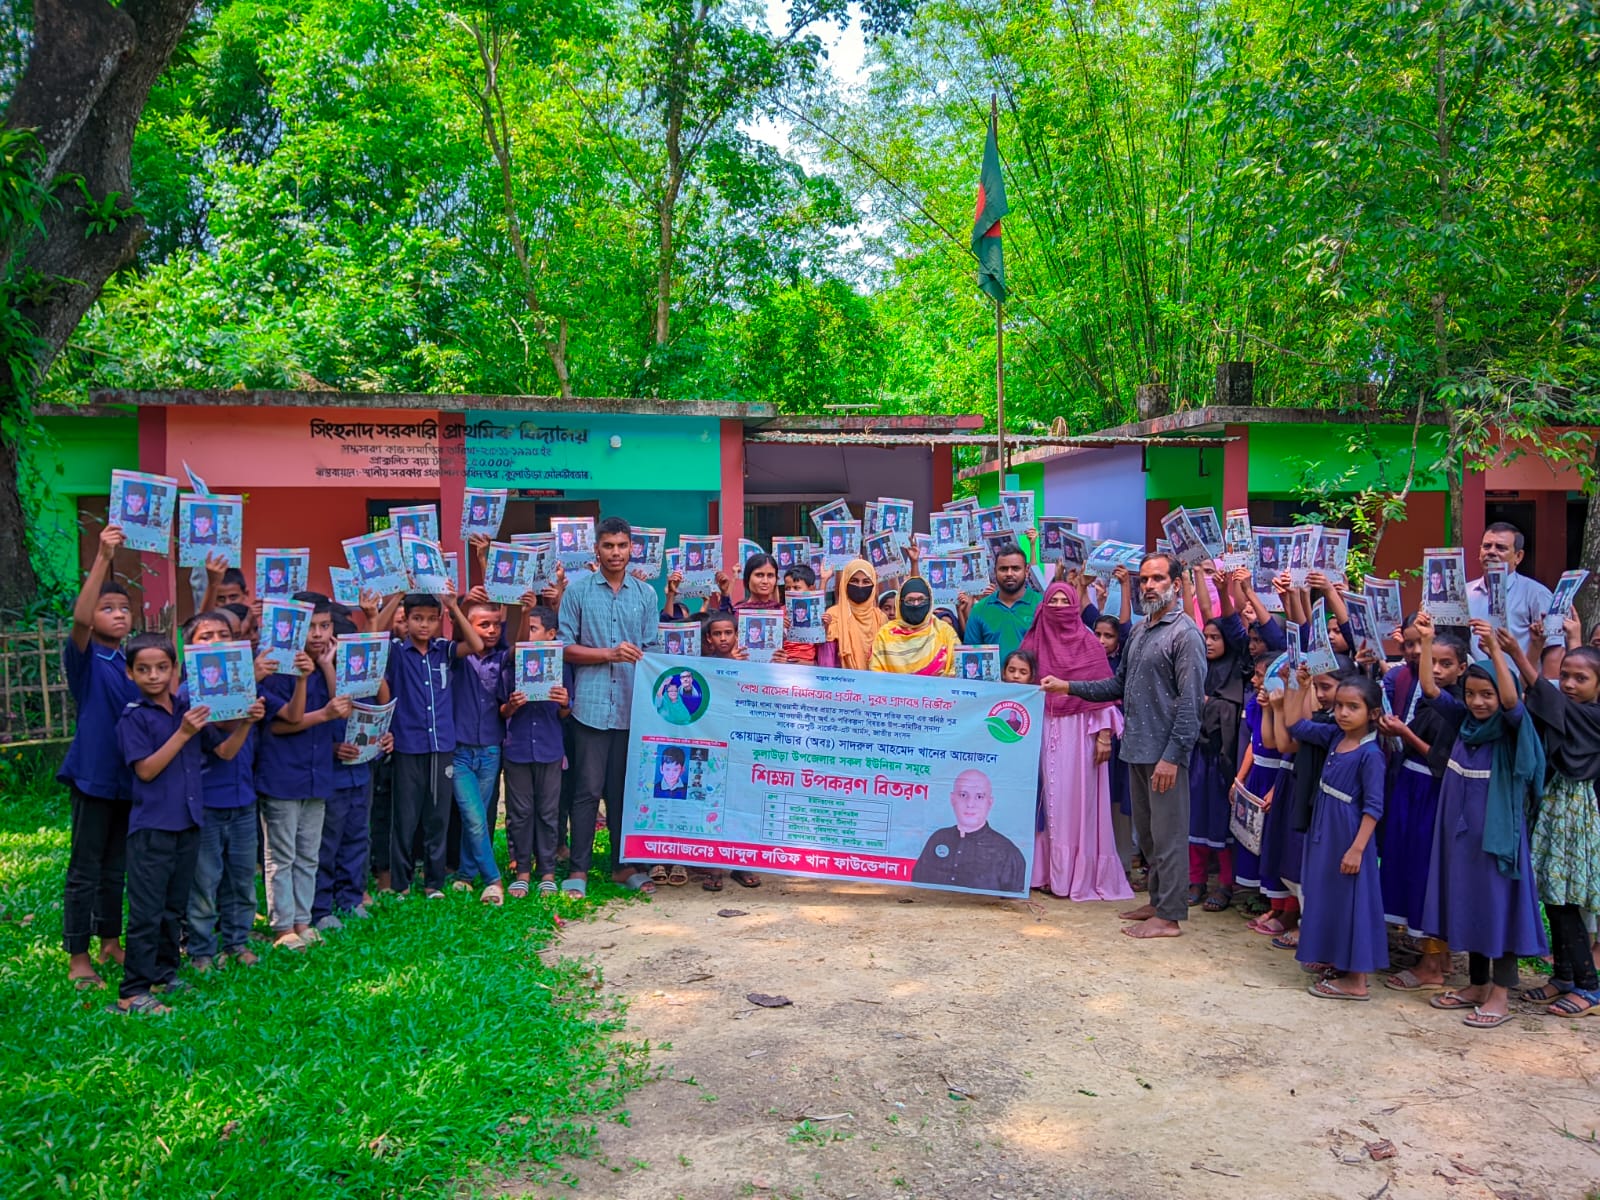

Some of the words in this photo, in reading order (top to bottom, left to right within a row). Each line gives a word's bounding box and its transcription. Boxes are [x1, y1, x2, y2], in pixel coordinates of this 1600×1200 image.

[310, 418, 373, 440] সিংহনাদ
[376, 419, 437, 439] সরকারি
[442, 420, 514, 440] প্রাথমিক
[520, 420, 587, 444] বিদ্যালয়
[390, 469, 422, 478] সরকার
[762, 685, 789, 696] রাসেল
[890, 695, 919, 709] প্রাণবন্ত
[774, 731, 801, 746] লীডার
[839, 741, 872, 754] সাদরুল
[877, 743, 914, 758] আহমেদ
[919, 747, 946, 760] খানের
[950, 749, 998, 764] আয়োজনে
[752, 748, 789, 762] কুলাউড়া
[792, 750, 836, 766] উপজেলার
[839, 755, 862, 768] সকল
[866, 755, 902, 772] ইউনিয়ন
[905, 763, 932, 777] সমূহে
[751, 764, 795, 788] শিক্ষা
[801, 768, 867, 796] উপকরণ
[874, 774, 929, 801] বিতরণ
[643, 840, 714, 858] আয়োজনেঃ
[718, 845, 757, 864] আব্দুল
[761, 847, 801, 866] লতিফ
[805, 855, 830, 870] খান
[833, 855, 899, 876] ফাউন্ডেশন
